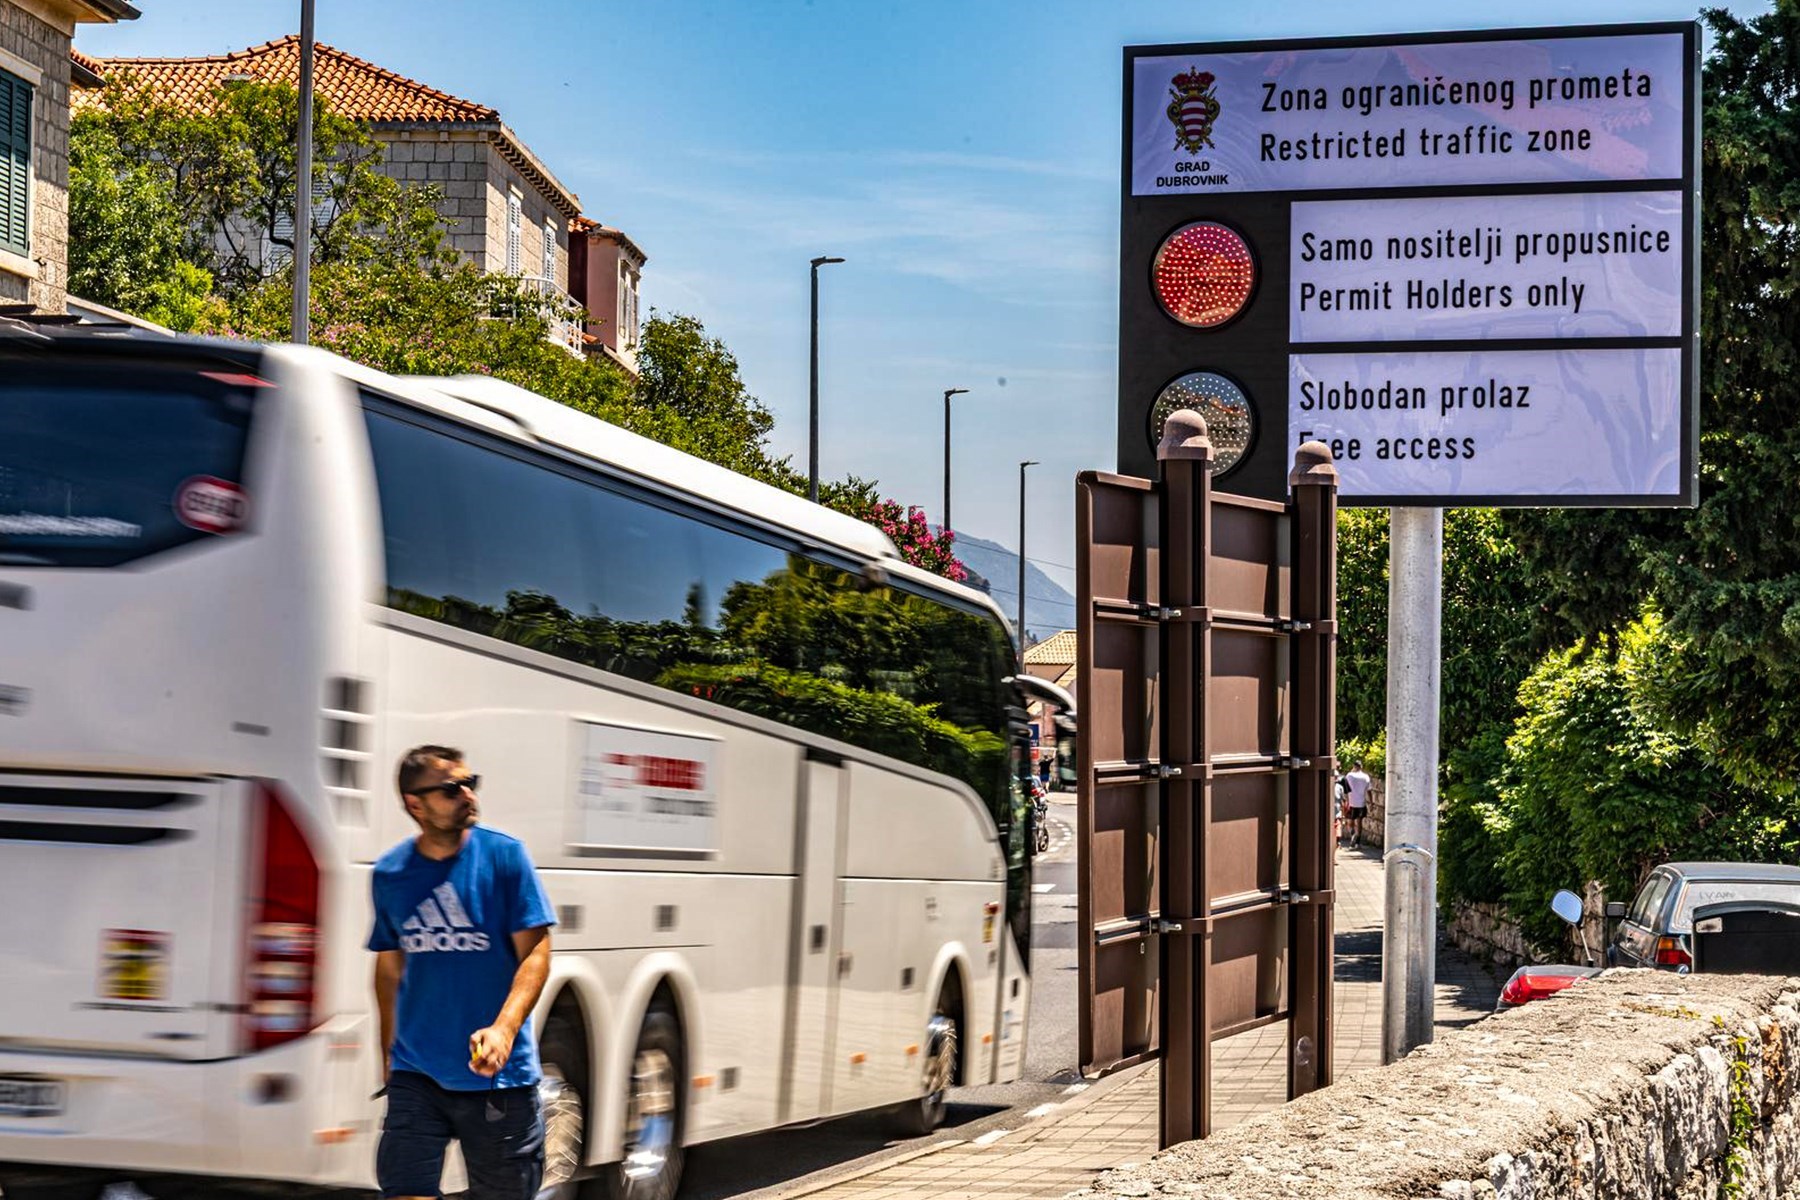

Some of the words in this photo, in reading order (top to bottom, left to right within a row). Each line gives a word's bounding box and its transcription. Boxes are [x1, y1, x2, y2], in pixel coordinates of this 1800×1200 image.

[1261, 83, 1327, 112] Zona
[1342, 76, 1514, 116] ograničenog
[1530, 68, 1650, 109] prometa
[1261, 129, 1404, 161] Restricted
[1420, 125, 1512, 155] traffic
[1528, 129, 1590, 151] zone
[1157, 175, 1228, 187] DUBROVNIK
[1175, 161, 1210, 172] GRAD
[1302, 233, 1372, 261] Samo
[1388, 228, 1500, 264] nositelji
[1516, 225, 1669, 263] propusnice
[1301, 282, 1391, 311] Permit
[1408, 279, 1511, 308] Holders
[1528, 277, 1584, 313] only
[1300, 381, 1425, 410] Slobodan
[1442, 379, 1529, 416] prolaz
[1299, 431, 1361, 461] Fee
[1377, 438, 1474, 459] access
